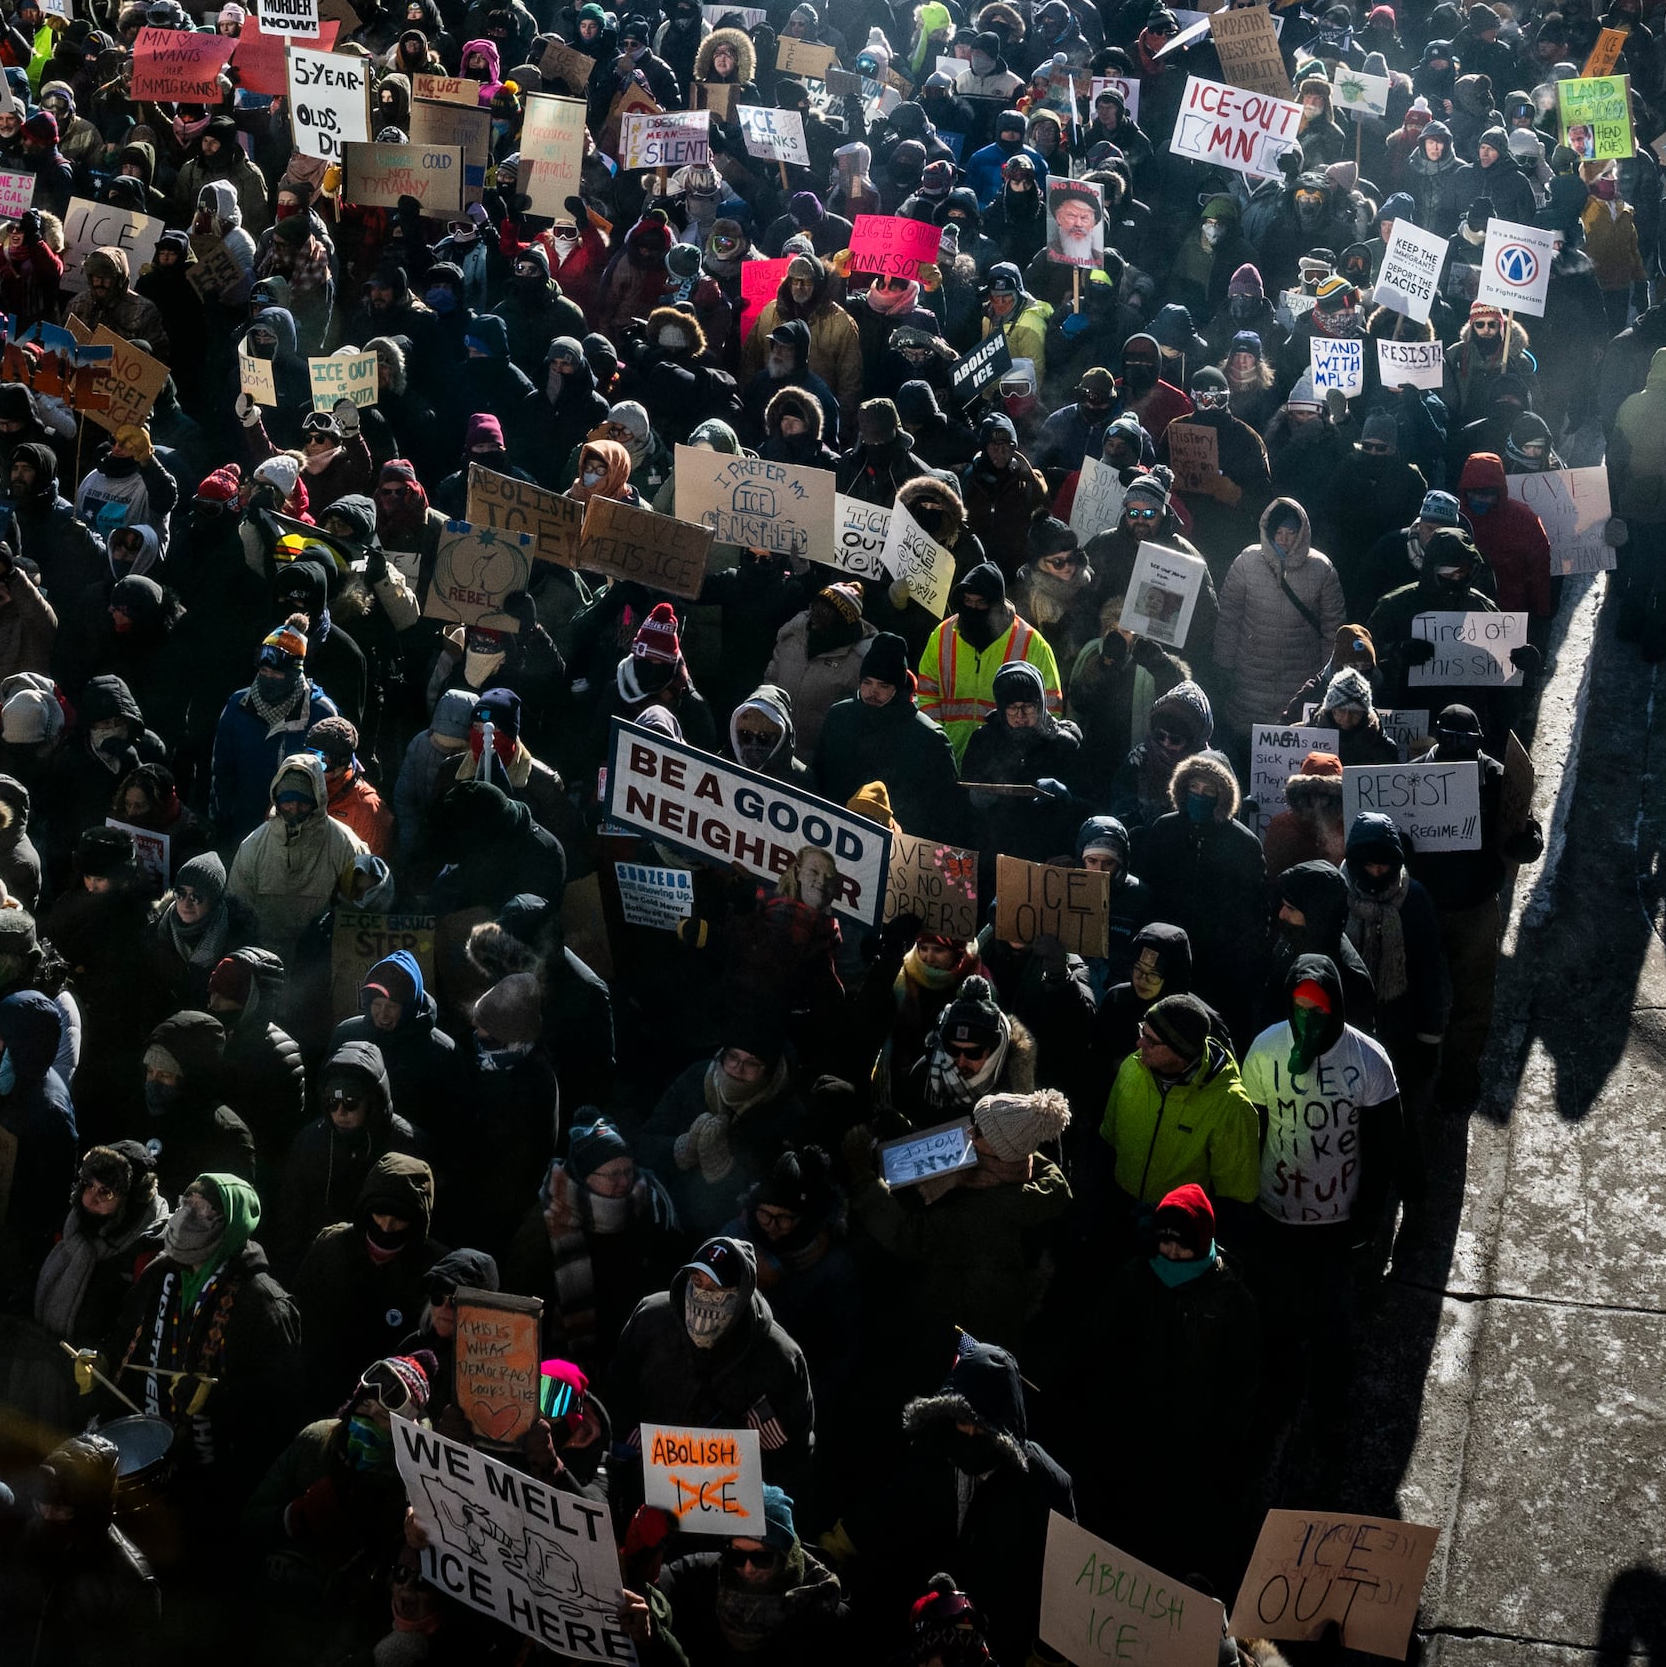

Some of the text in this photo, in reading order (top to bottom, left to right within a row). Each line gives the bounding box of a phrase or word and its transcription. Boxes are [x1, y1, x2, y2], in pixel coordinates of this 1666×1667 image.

[261, 17, 318, 33] NOW!
[293, 56, 365, 92] 5-YEAR-
[296, 102, 342, 133] OLDS,
[1190, 85, 1301, 131] ICE-OUT
[1207, 128, 1259, 163] MN
[855, 216, 895, 238] ICE
[1393, 247, 1435, 272] IMMIGRANTS
[1396, 237, 1439, 264] KEEP THE
[1385, 270, 1430, 300] RACISTS
[1388, 262, 1433, 288] DEPORT THE
[953, 333, 1005, 387] ABOLISH
[1312, 339, 1359, 357] STAND
[1317, 355, 1360, 373] WITH
[1381, 343, 1442, 365] RESIST!
[311, 357, 376, 382] ICE OUT
[972, 365, 995, 389] ICE
[1315, 371, 1357, 389] MPLS
[905, 525, 937, 565] ICE
[897, 544, 937, 584] OUT
[896, 564, 937, 605] NOW!
[629, 749, 866, 863] BE A GOOD
[1357, 770, 1456, 808] RESIST
[1409, 814, 1477, 839] REGIME!!!
[625, 784, 863, 909] NEIGHBR
[1026, 870, 1090, 912] ICE
[1015, 902, 1094, 959] OUT
[653, 1436, 736, 1465] ABOLISH
[399, 1422, 606, 1543] WE MELT
[1297, 1524, 1381, 1573] ICE
[423, 1547, 637, 1665] ICE HERE
[1074, 1553, 1185, 1635] ABOLISH
[1256, 1574, 1382, 1632] OUT
[1086, 1606, 1138, 1661] ICE
